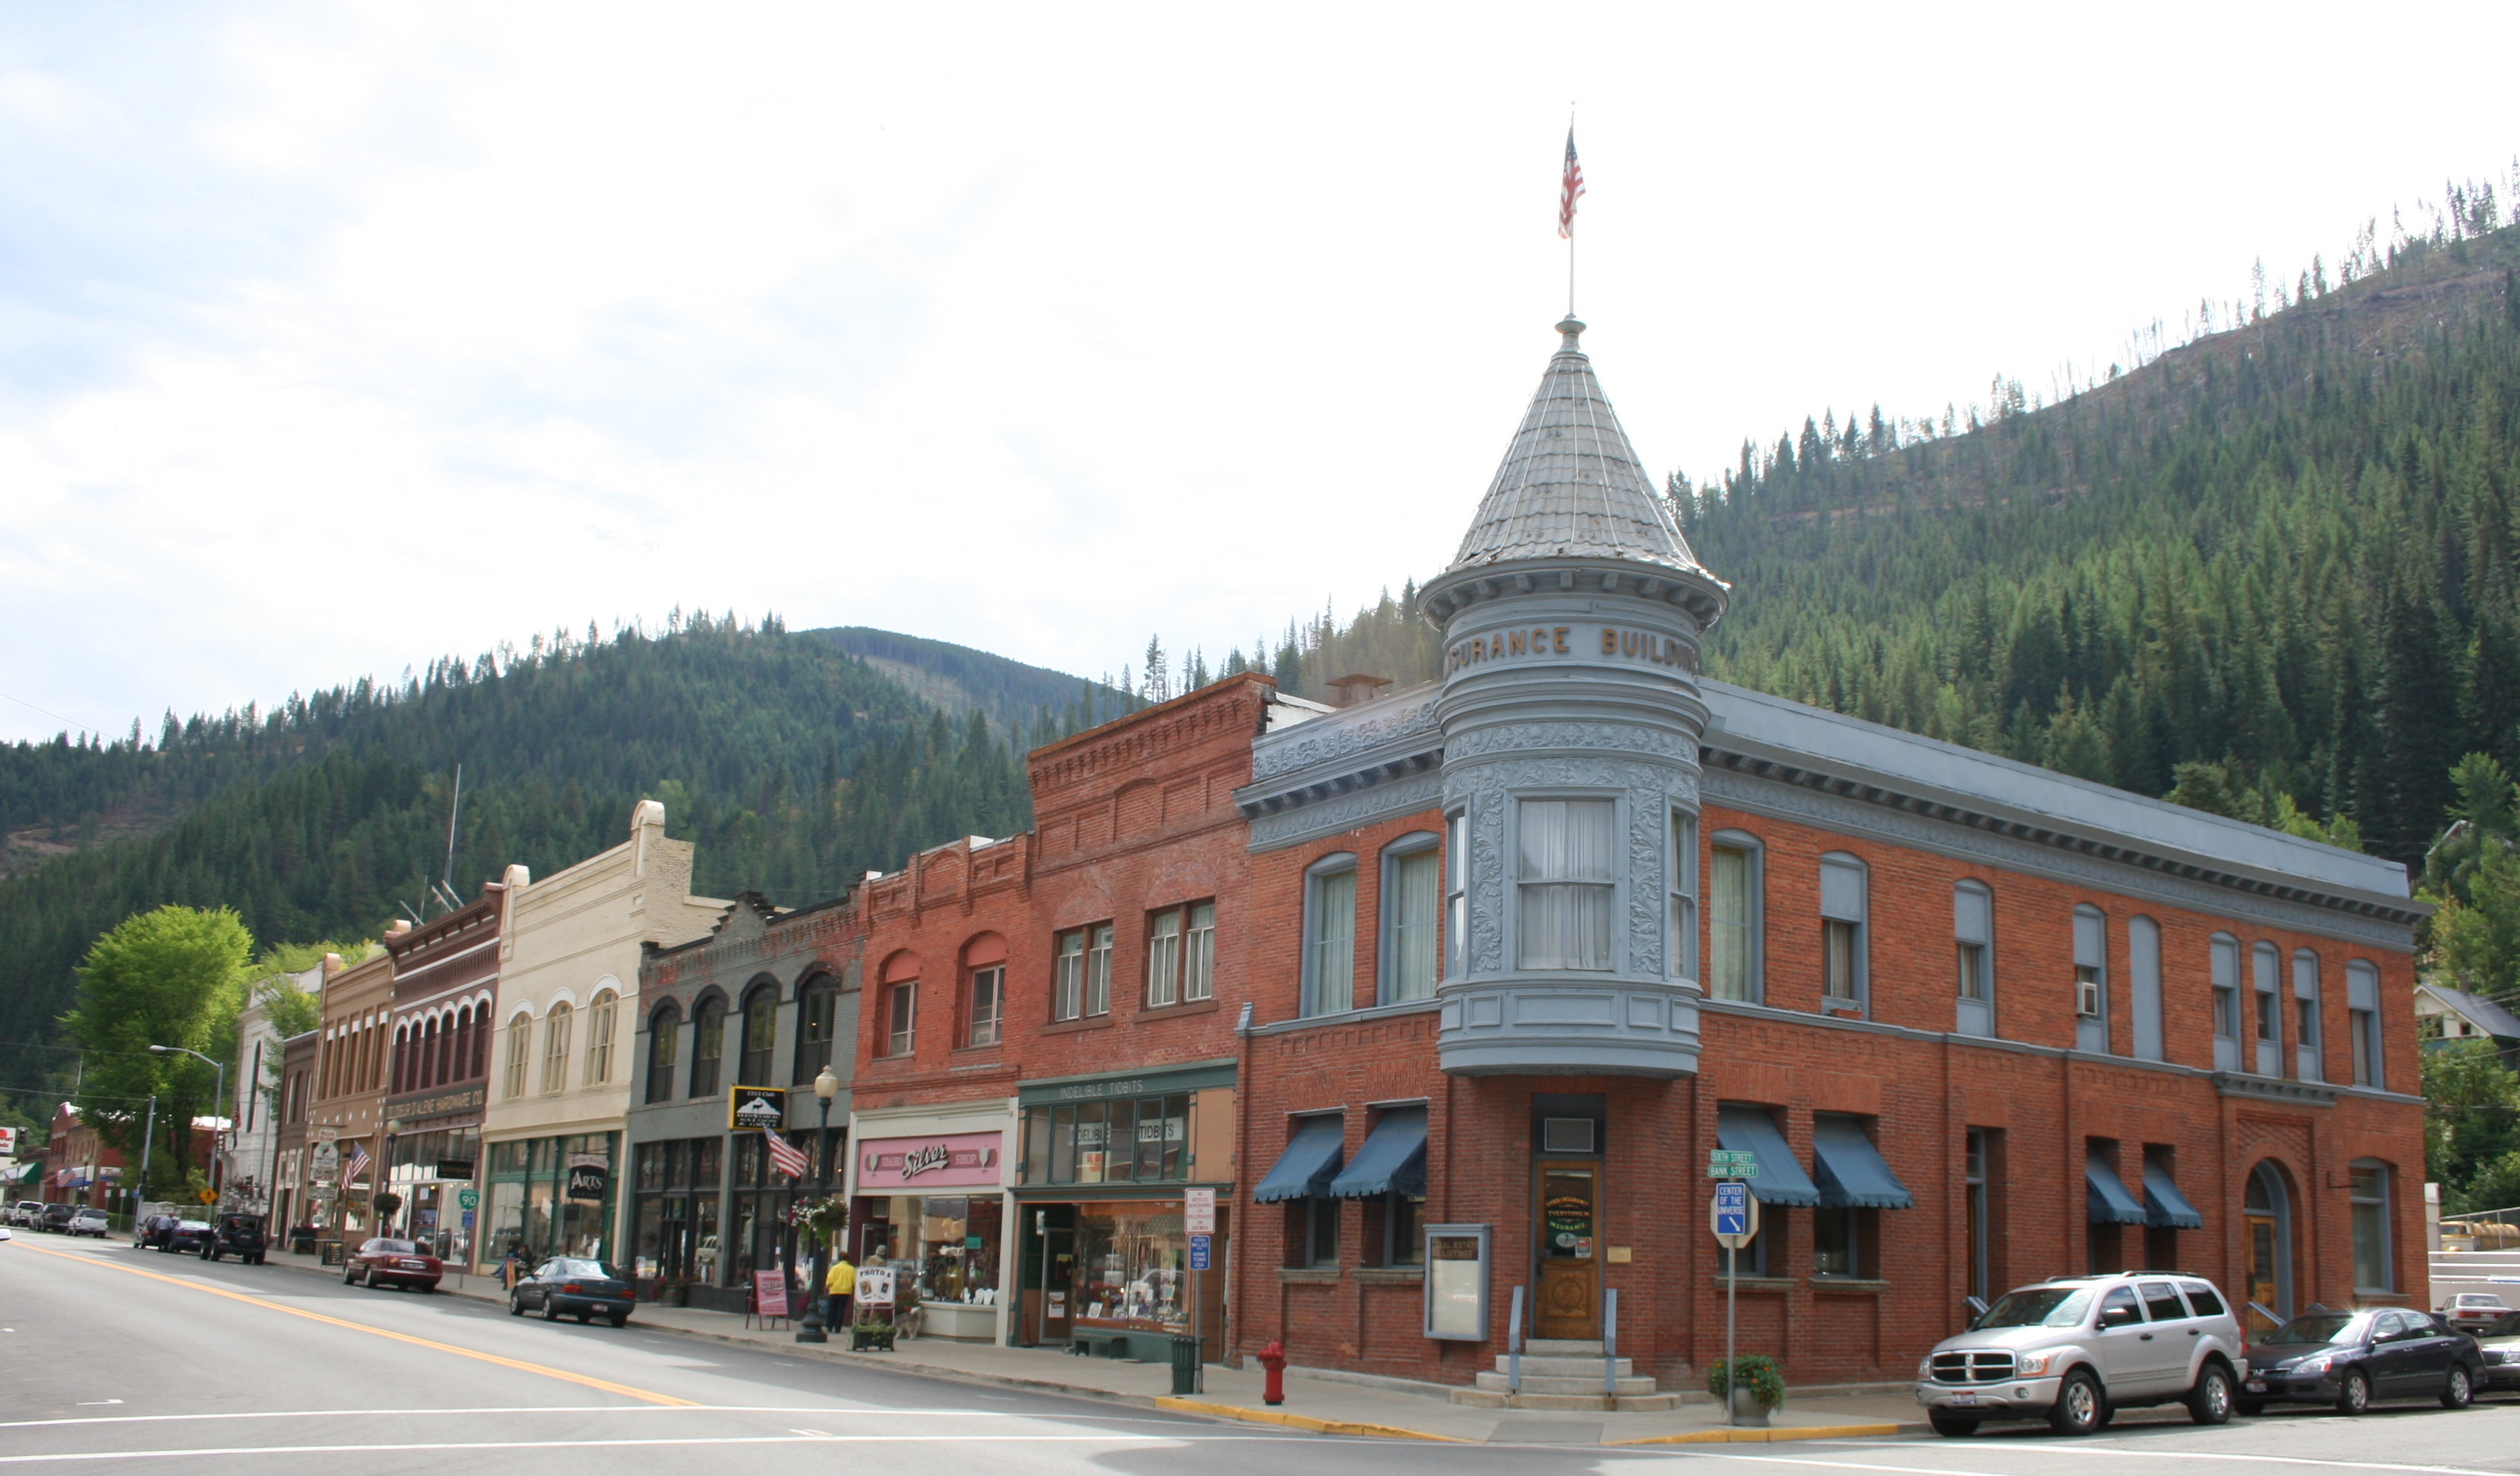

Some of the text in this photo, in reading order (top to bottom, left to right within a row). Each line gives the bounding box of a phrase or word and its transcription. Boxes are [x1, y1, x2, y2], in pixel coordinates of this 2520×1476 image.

[1447, 627, 1695, 677] SURANCE BUILDIN
[1060, 1079, 1143, 1099] INDELIBLE TIDBITS
[437, 1091, 472, 1113] HARDWARE
[1070, 1123, 1174, 1142] DELIBLE TIDBTS
[881, 1144, 977, 1180] IDAHO Silver SHOP
[1712, 1151, 1752, 1163] SIXTH STREET
[1710, 1166, 1756, 1176] BANK STREET
[1719, 1186, 1743, 1196] CENTER
[462, 1195, 477, 1206] 90
[1719, 1196, 1742, 1205] OF THE
[1718, 1206, 1744, 1215] UNIVERSE
[1443, 1250, 1473, 1258] LISTINGS
